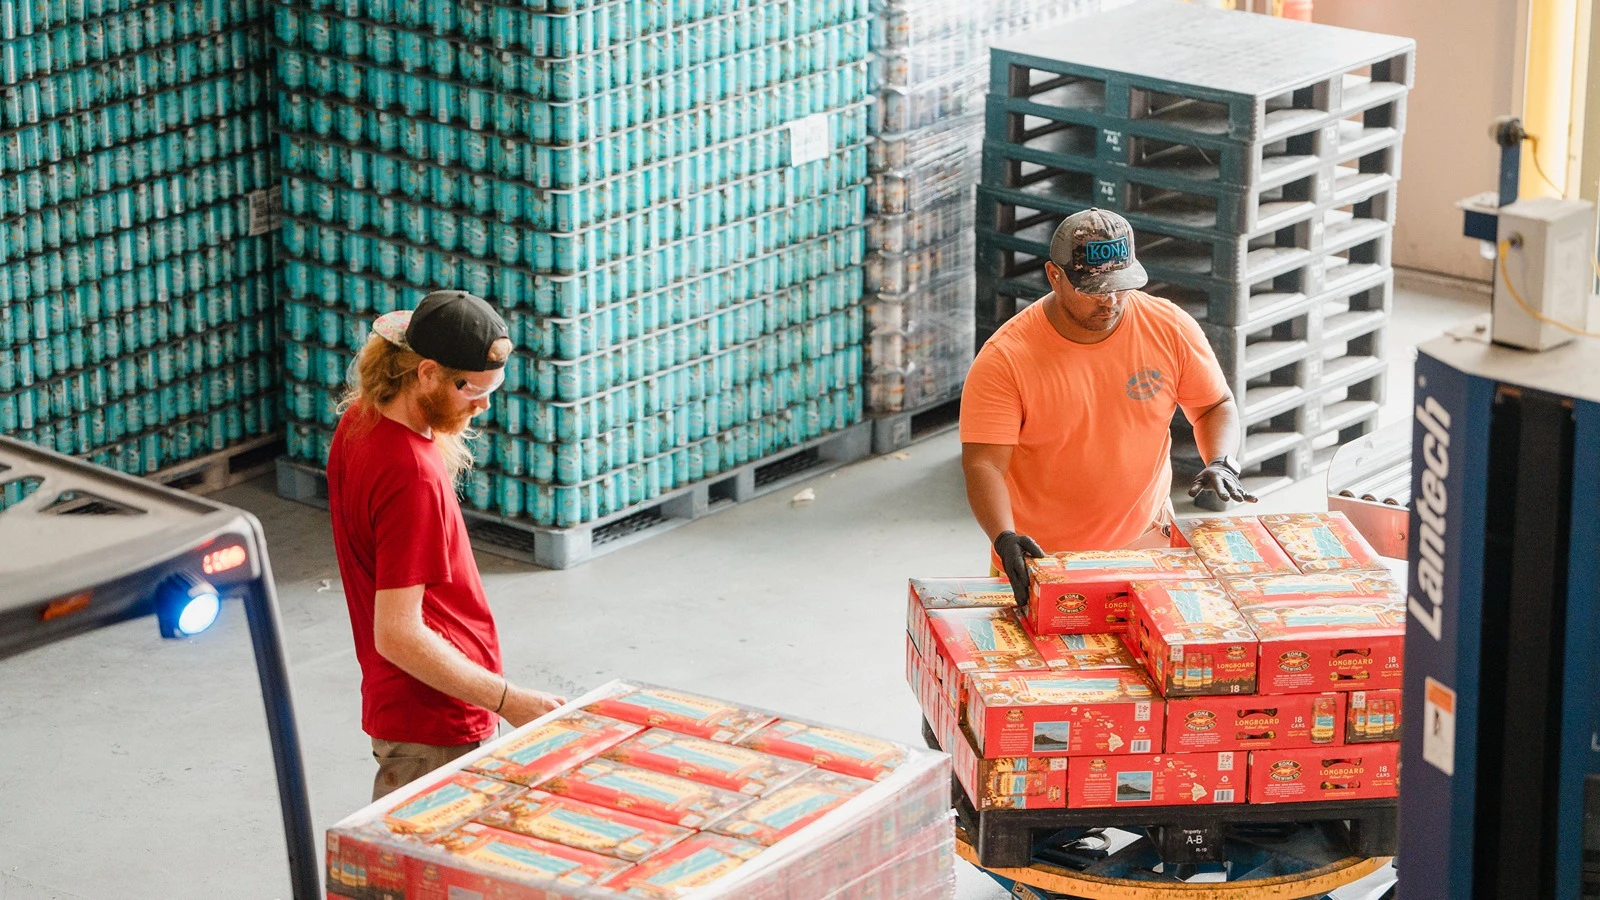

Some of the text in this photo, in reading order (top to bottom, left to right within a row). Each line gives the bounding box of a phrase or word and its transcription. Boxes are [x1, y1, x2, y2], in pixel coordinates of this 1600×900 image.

[1090, 240, 1128, 260] KONA
[1408, 396, 1451, 641] Lantech
[1328, 659, 1373, 667] LONGBOARD
[1235, 718, 1279, 726] LONGBOARD
[1320, 767, 1364, 775] LONGBOARD
[1186, 835, 1203, 844] A-B
